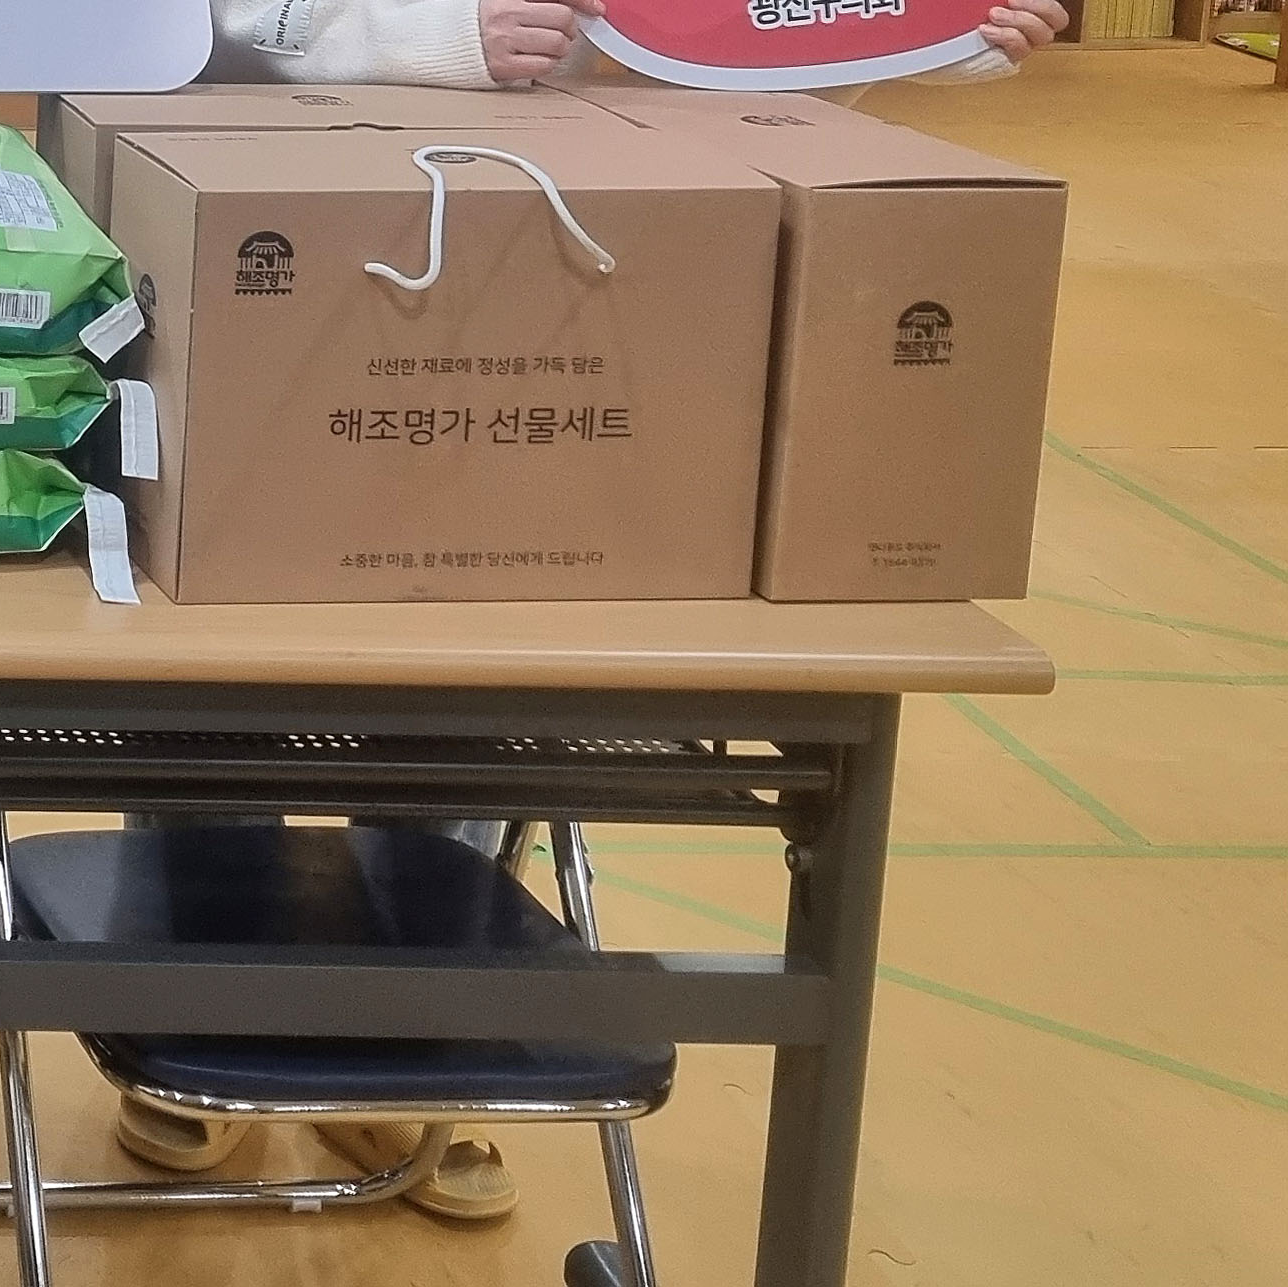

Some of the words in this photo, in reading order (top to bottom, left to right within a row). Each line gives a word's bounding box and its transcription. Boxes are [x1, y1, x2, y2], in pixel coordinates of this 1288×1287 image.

[367, 358, 417, 376] 신선한
[421, 357, 472, 374] 재료에
[478, 357, 527, 376] 정성을
[533, 356, 566, 374] 가득
[571, 356, 604, 375] 담은
[328, 407, 476, 446] 해조명가
[487, 406, 633, 444] 선물세트
